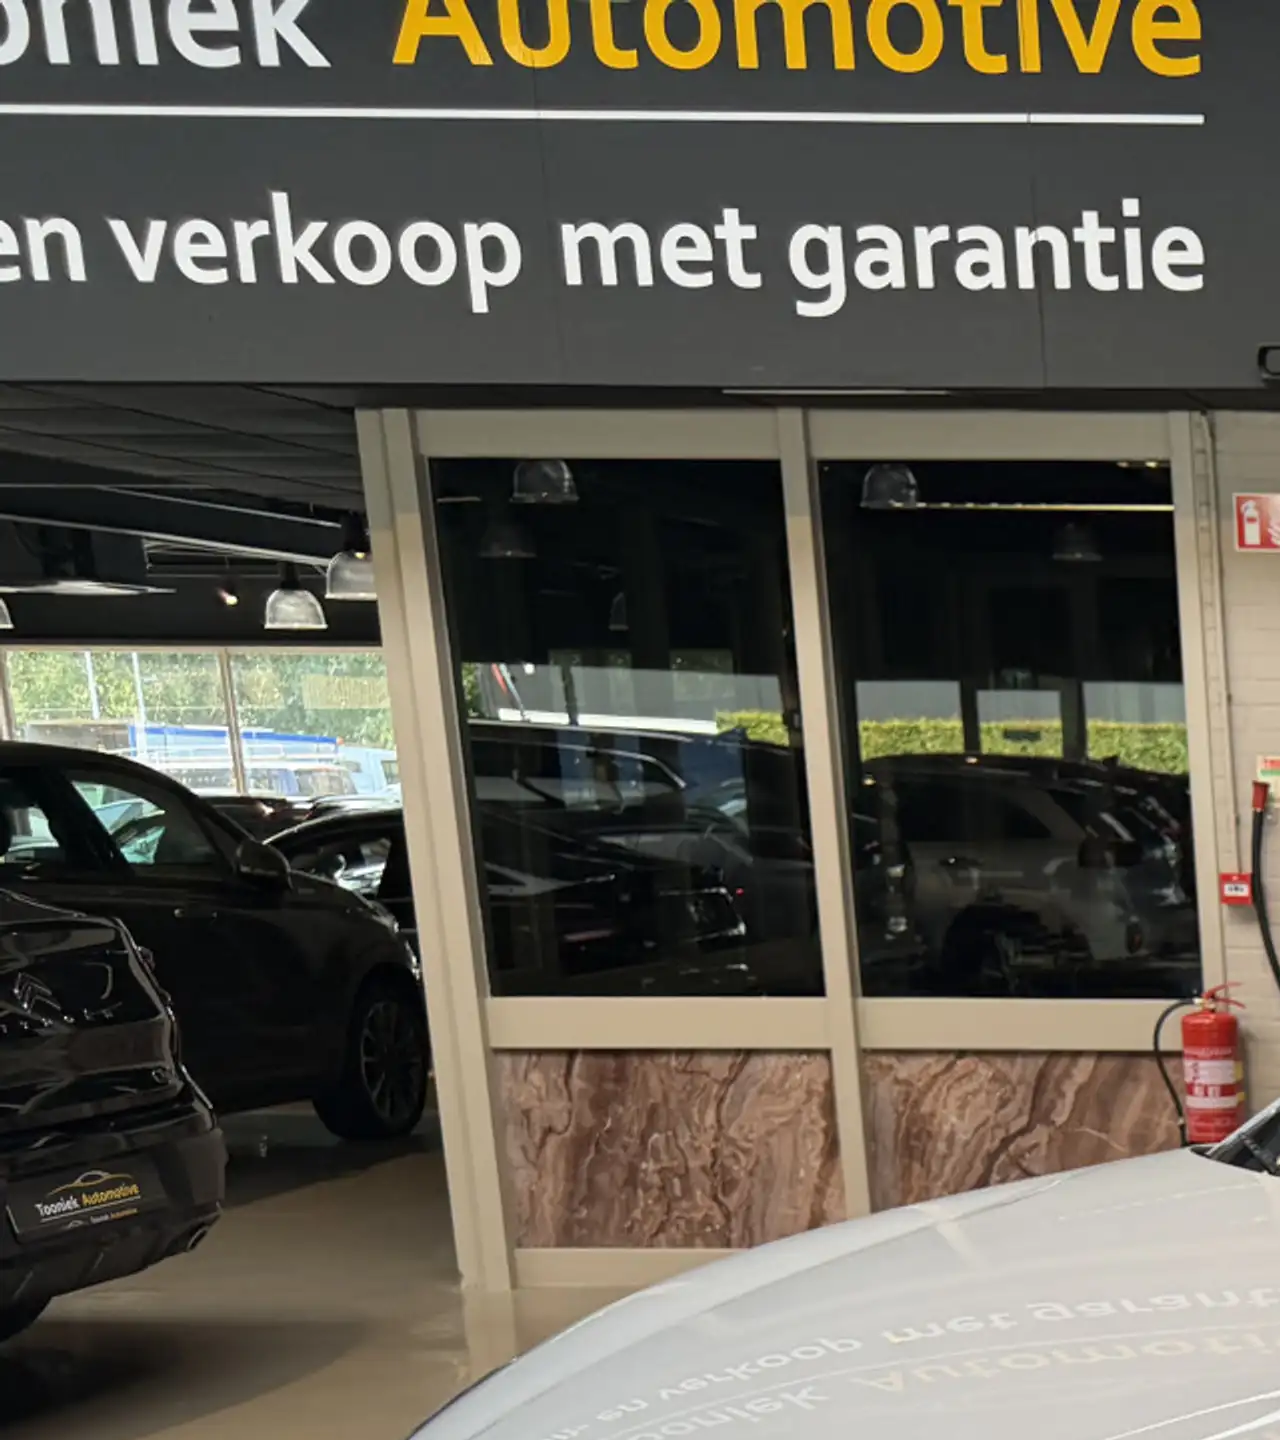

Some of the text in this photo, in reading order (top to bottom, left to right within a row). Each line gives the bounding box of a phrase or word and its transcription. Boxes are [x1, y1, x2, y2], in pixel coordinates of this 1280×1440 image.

[392, 0, 1201, 77] Automotive
[109, 191, 521, 313] verkoop
[561, 207, 762, 289] met
[788, 198, 1205, 318] garantie
